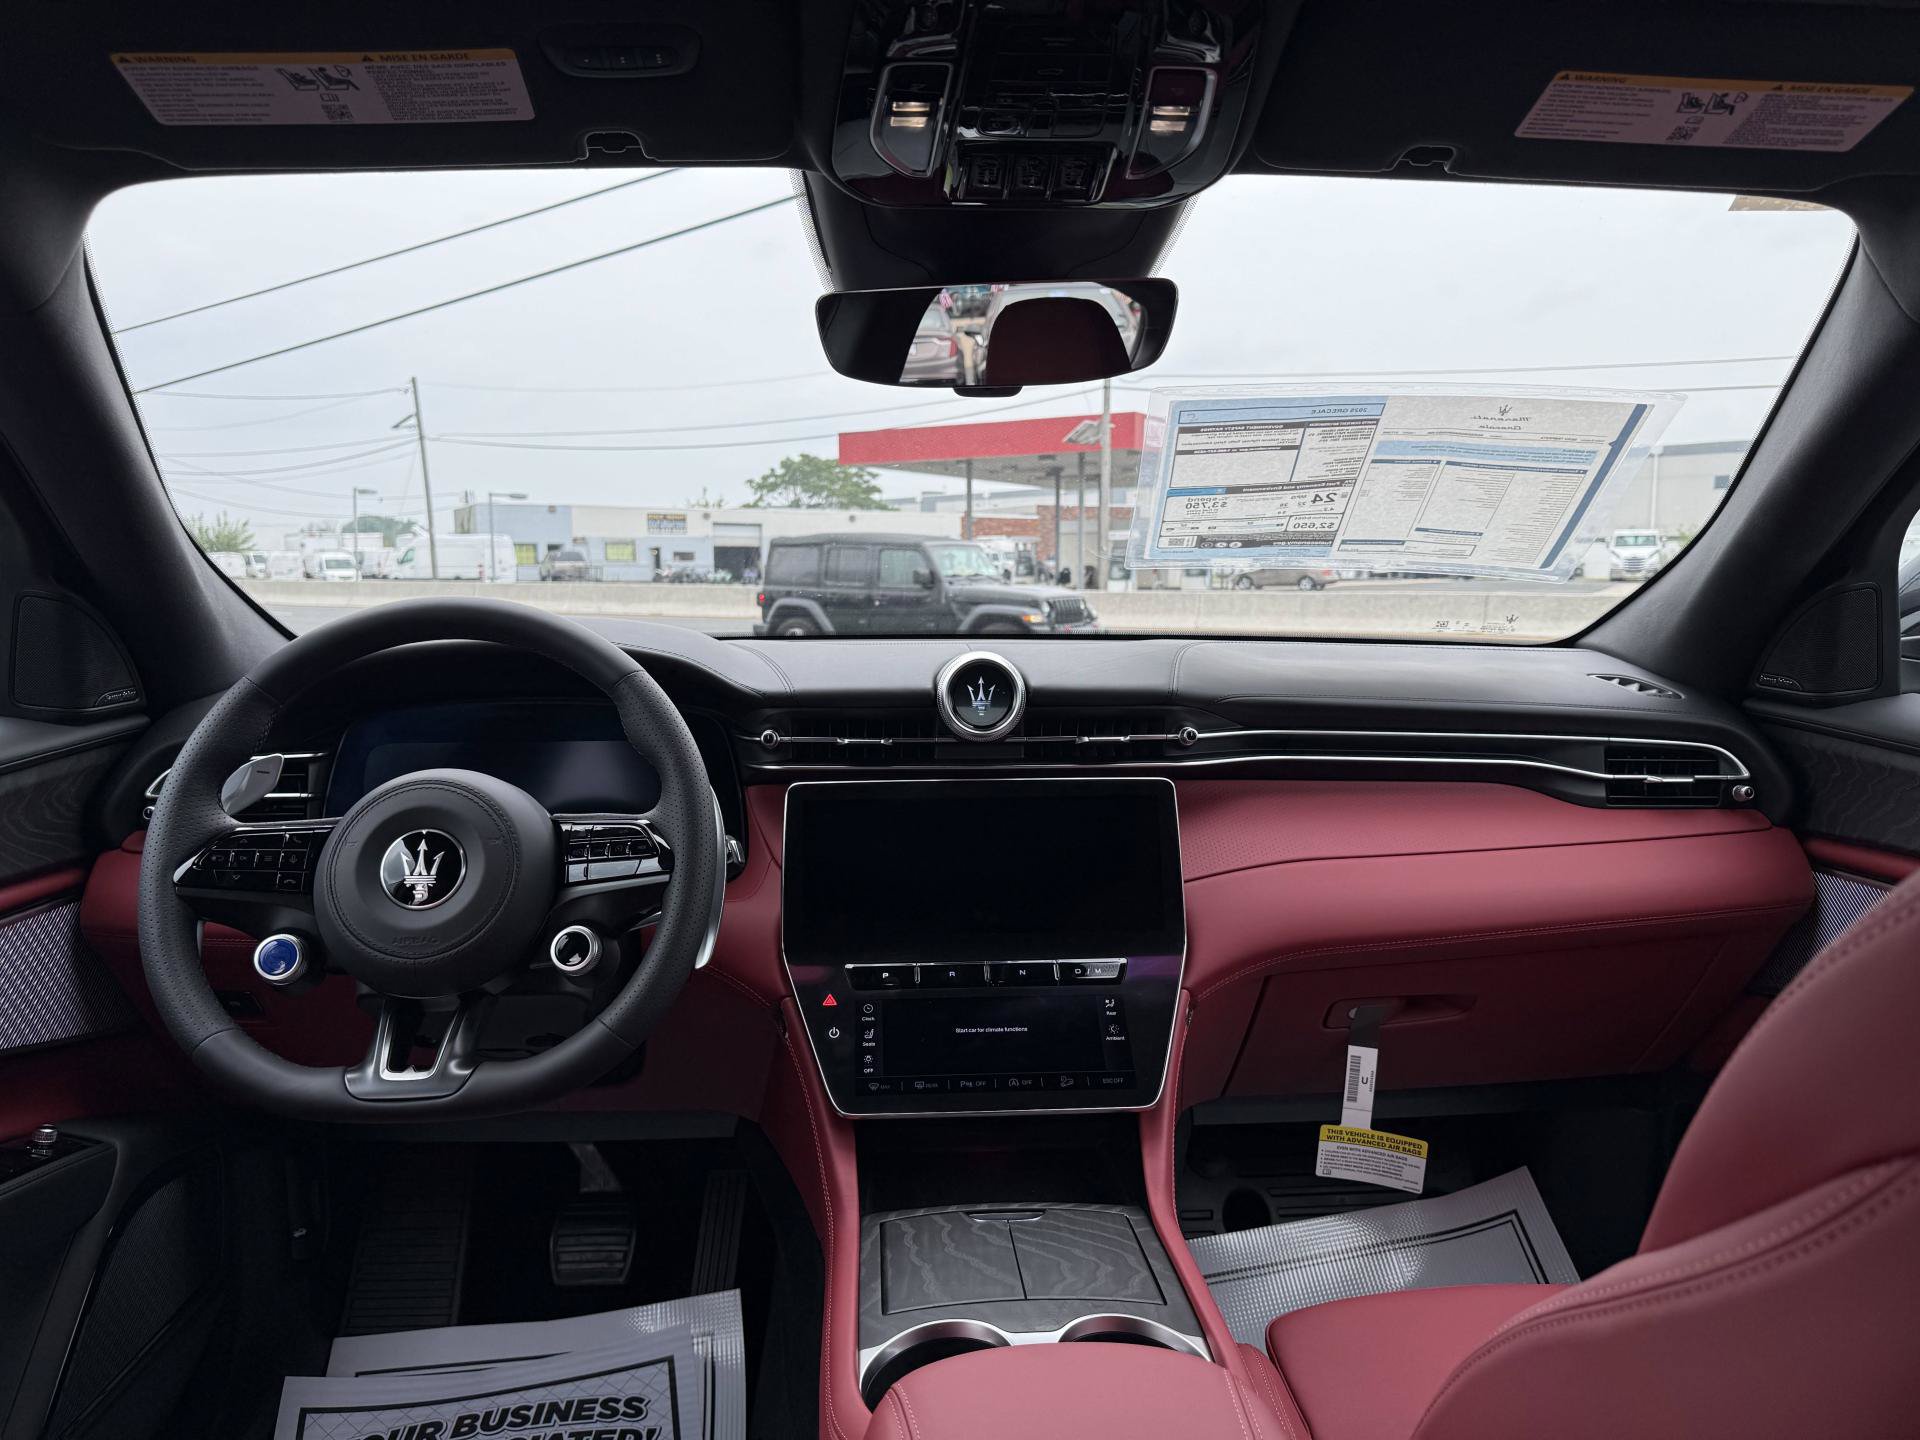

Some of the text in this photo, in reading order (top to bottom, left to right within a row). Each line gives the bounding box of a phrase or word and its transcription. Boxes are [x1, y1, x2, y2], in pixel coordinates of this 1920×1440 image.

[134, 56, 197, 64] WARNING
[379, 54, 407, 62] MISE
[430, 53, 469, 61] GARDE
[1327, 1128, 1344, 1136] THIS
[1344, 1131, 1376, 1140] VEHICLE
[1386, 1136, 1423, 1150] EQUIPPED
[1347, 1137, 1387, 1147] ADVANCED
[1388, 1143, 1401, 1151] AIR
[1402, 1146, 1422, 1156] BAGS
[450, 1396, 648, 1439] BUSINESS
